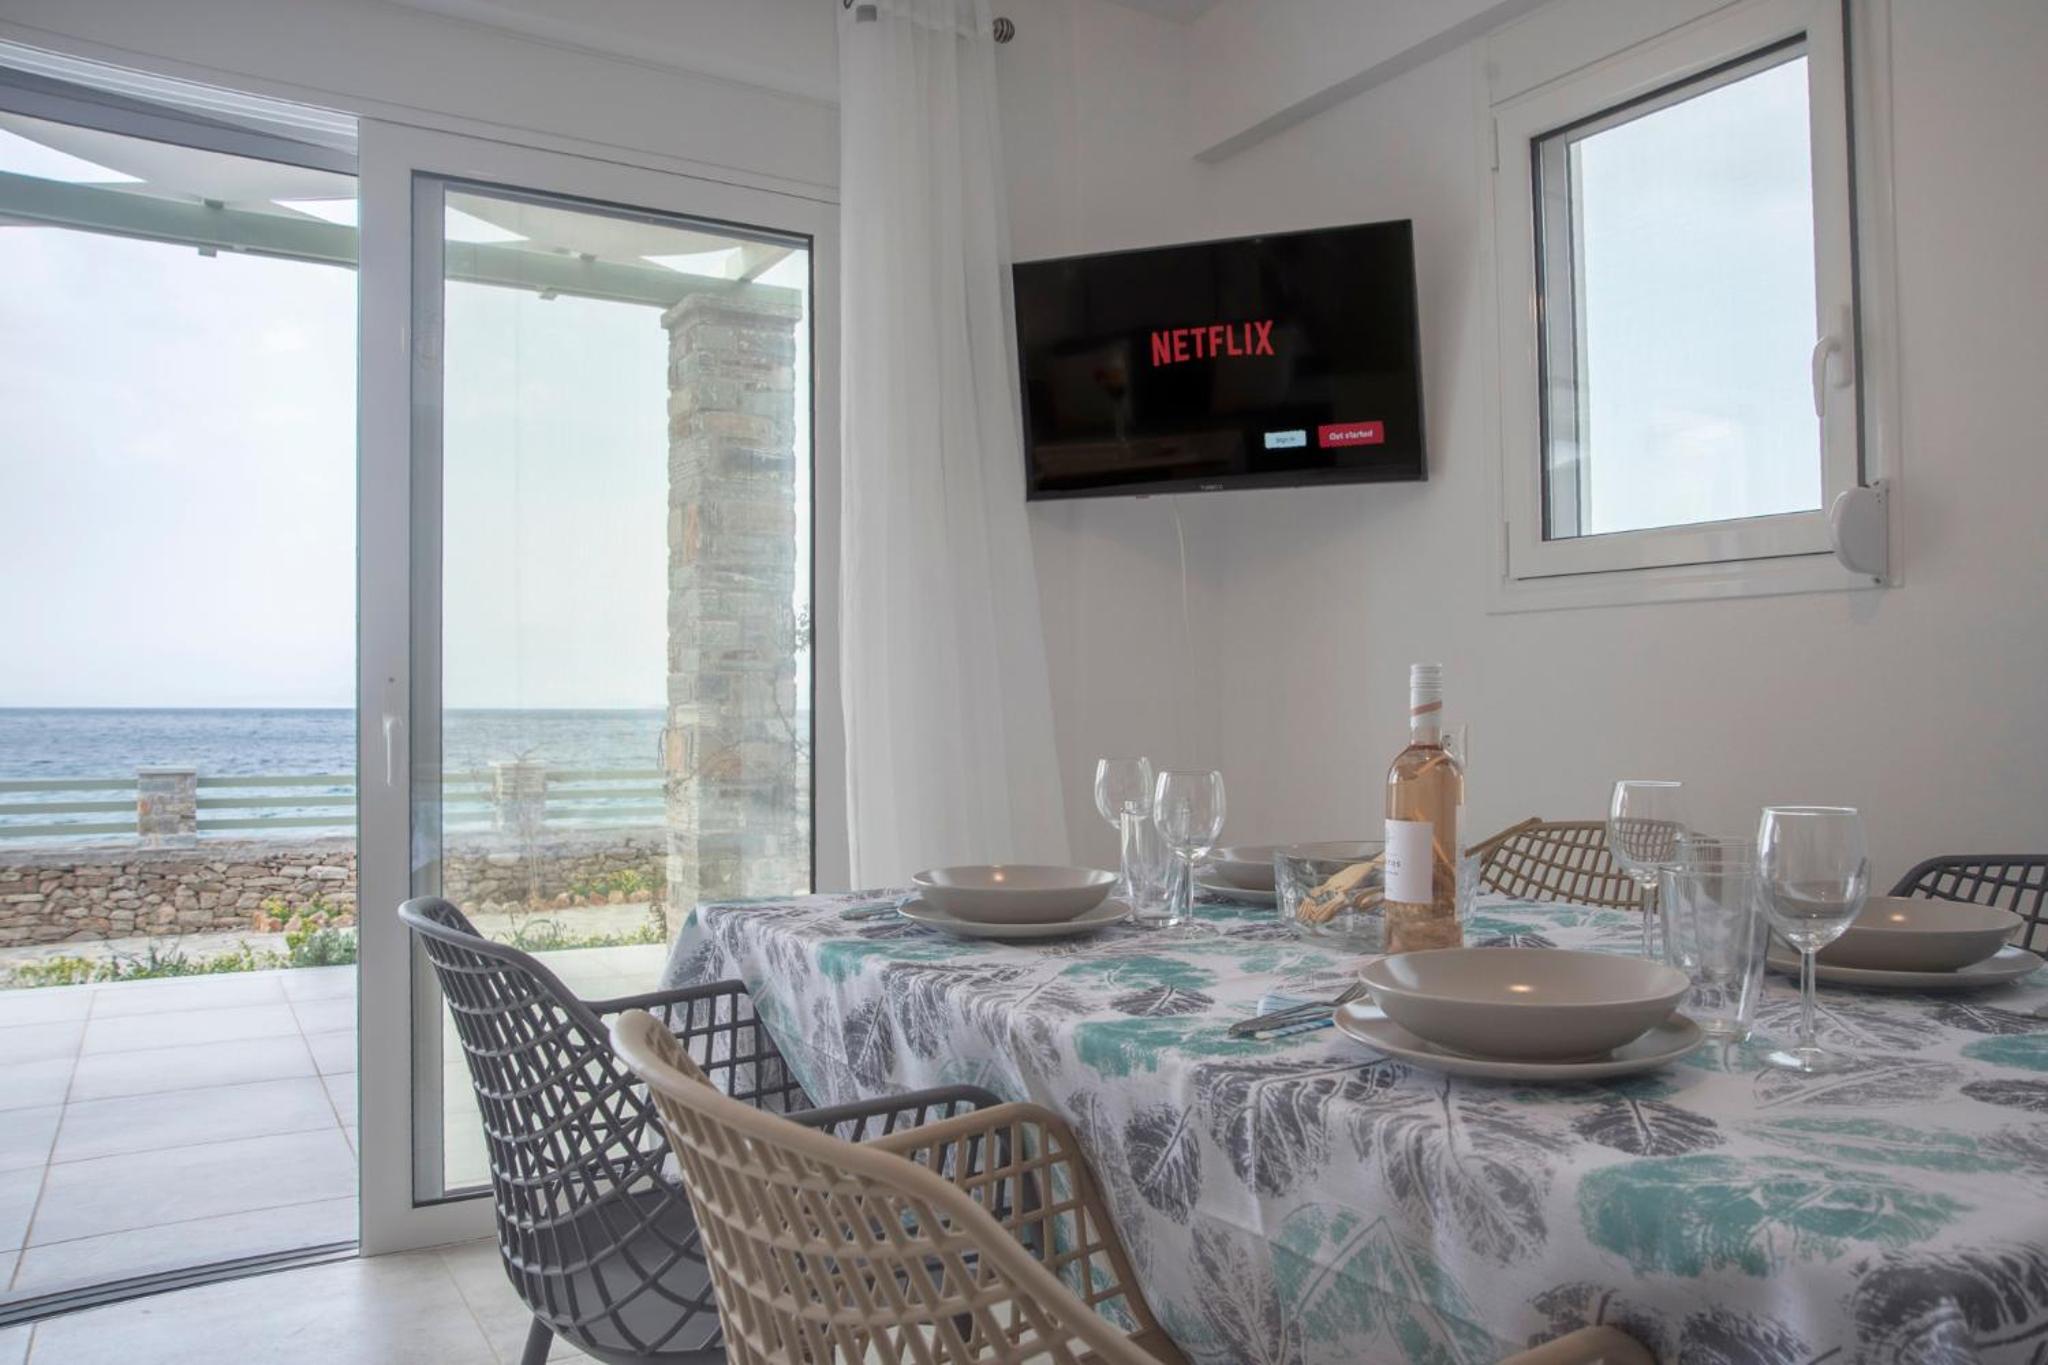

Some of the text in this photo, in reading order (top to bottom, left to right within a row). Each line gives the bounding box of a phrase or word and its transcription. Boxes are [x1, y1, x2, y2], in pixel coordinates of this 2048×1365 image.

[1152, 320, 1274, 366] NETFLIX
[1328, 429, 1374, 441] Get started
